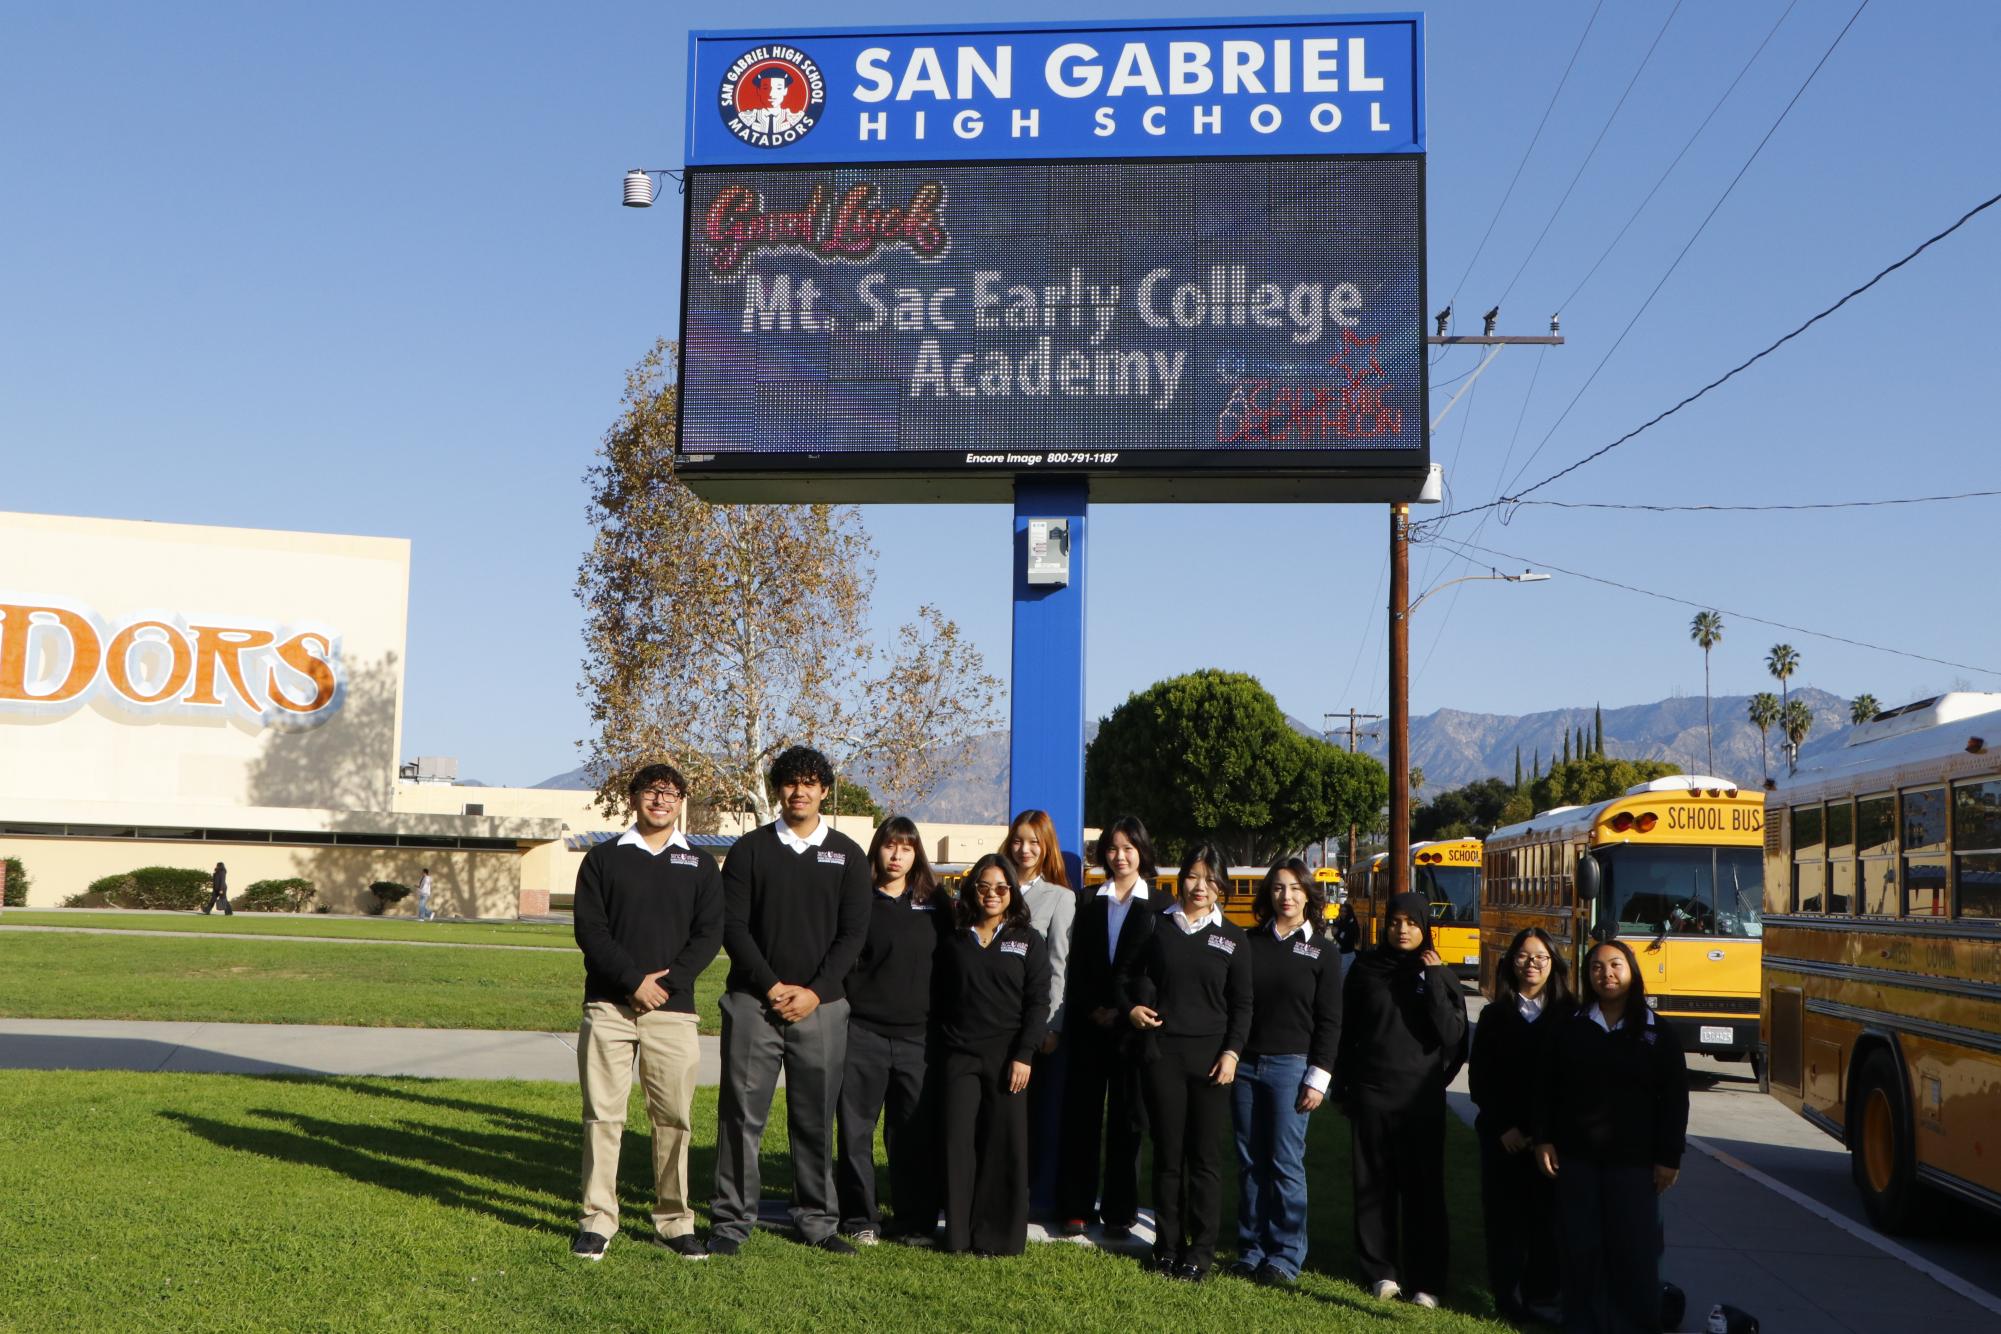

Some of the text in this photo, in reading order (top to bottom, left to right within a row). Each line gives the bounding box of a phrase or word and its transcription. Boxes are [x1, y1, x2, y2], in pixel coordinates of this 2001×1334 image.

[721, 46, 824, 106] SAN GABRIEL HIGH SCHOOL
[853, 37, 1384, 103] SAN GABRIEL
[728, 116, 814, 146] MATADORS
[859, 102, 1391, 141] HIGH SCHOOL
[821, 184, 942, 252] Luck
[743, 265, 1363, 345] Mt. Sac Early College
[911, 336, 1188, 409] Academy
[966, 452, 1119, 466] Encore Image 800-791-1187
[1668, 806, 1761, 832] SCHOOL BUS
